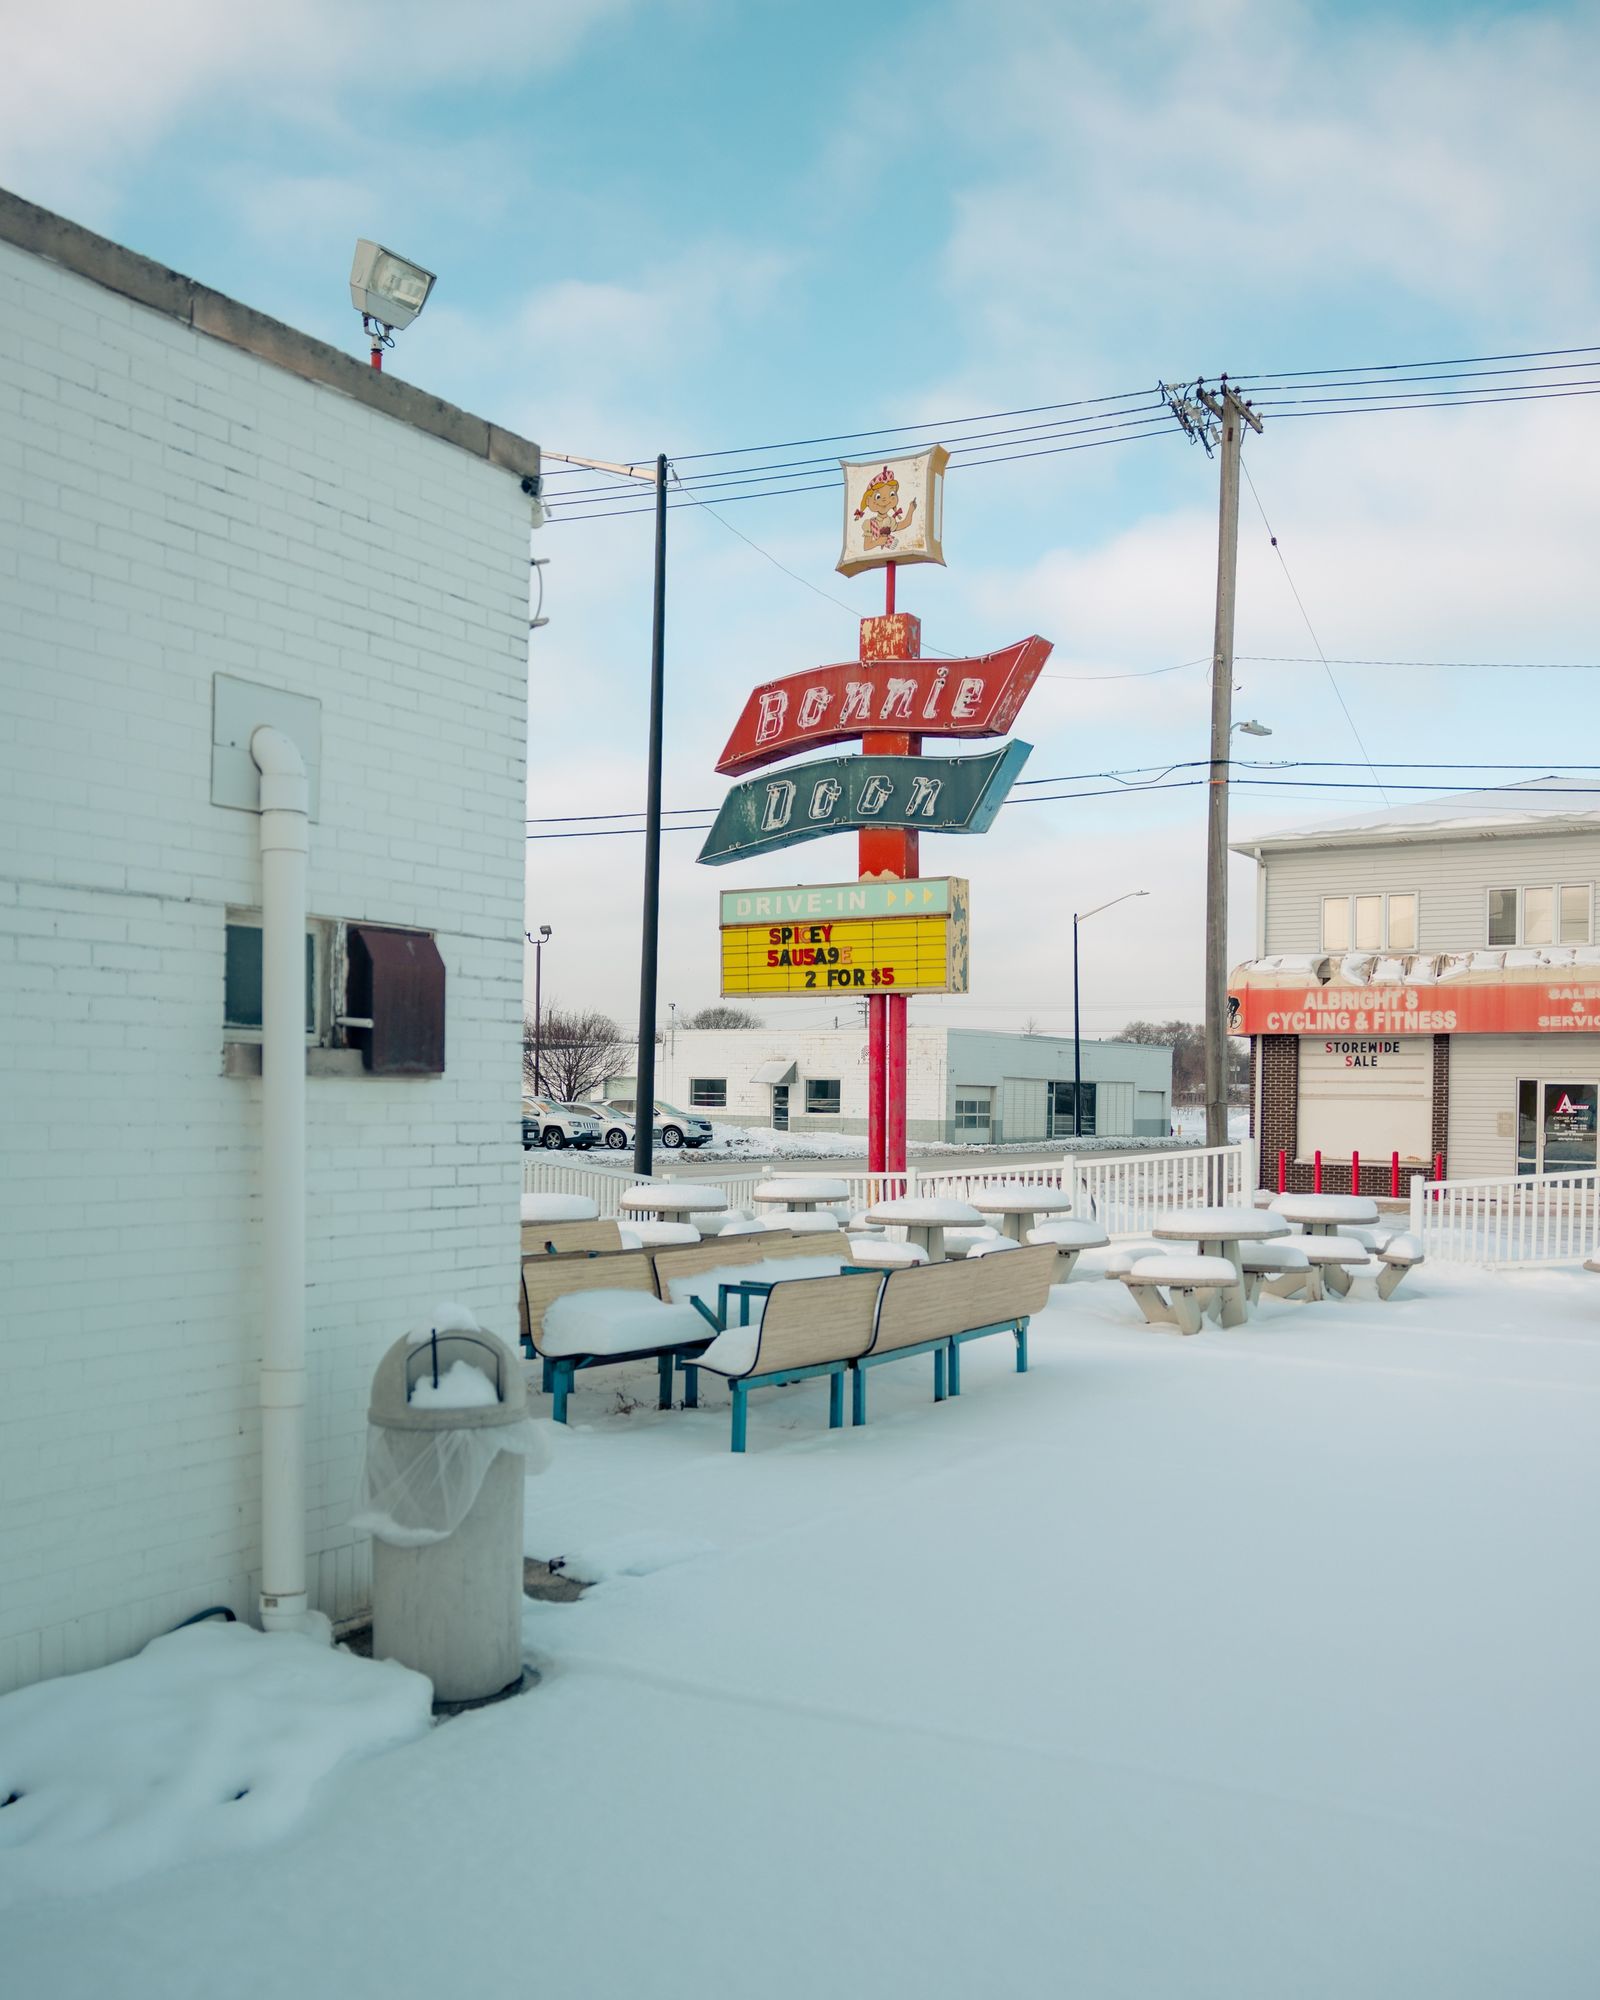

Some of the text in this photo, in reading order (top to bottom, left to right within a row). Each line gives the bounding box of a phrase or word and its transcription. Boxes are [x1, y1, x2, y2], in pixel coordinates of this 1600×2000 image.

[755, 666, 984, 745] Bonnie
[761, 775, 943, 831] Doon
[736, 890, 867, 917] DRIVE-IN
[769, 924, 833, 945] SPICEY
[805, 967, 895, 988] 2 FOR $5
[1303, 991, 1418, 1011] ALBRIGHT'S
[1571, 1001, 1585, 1013] &
[1267, 1010, 1457, 1031] CYCLING & FITNESS
[1325, 1041, 1400, 1053] STOREWIDE
[1345, 1055, 1378, 1067] SALE
